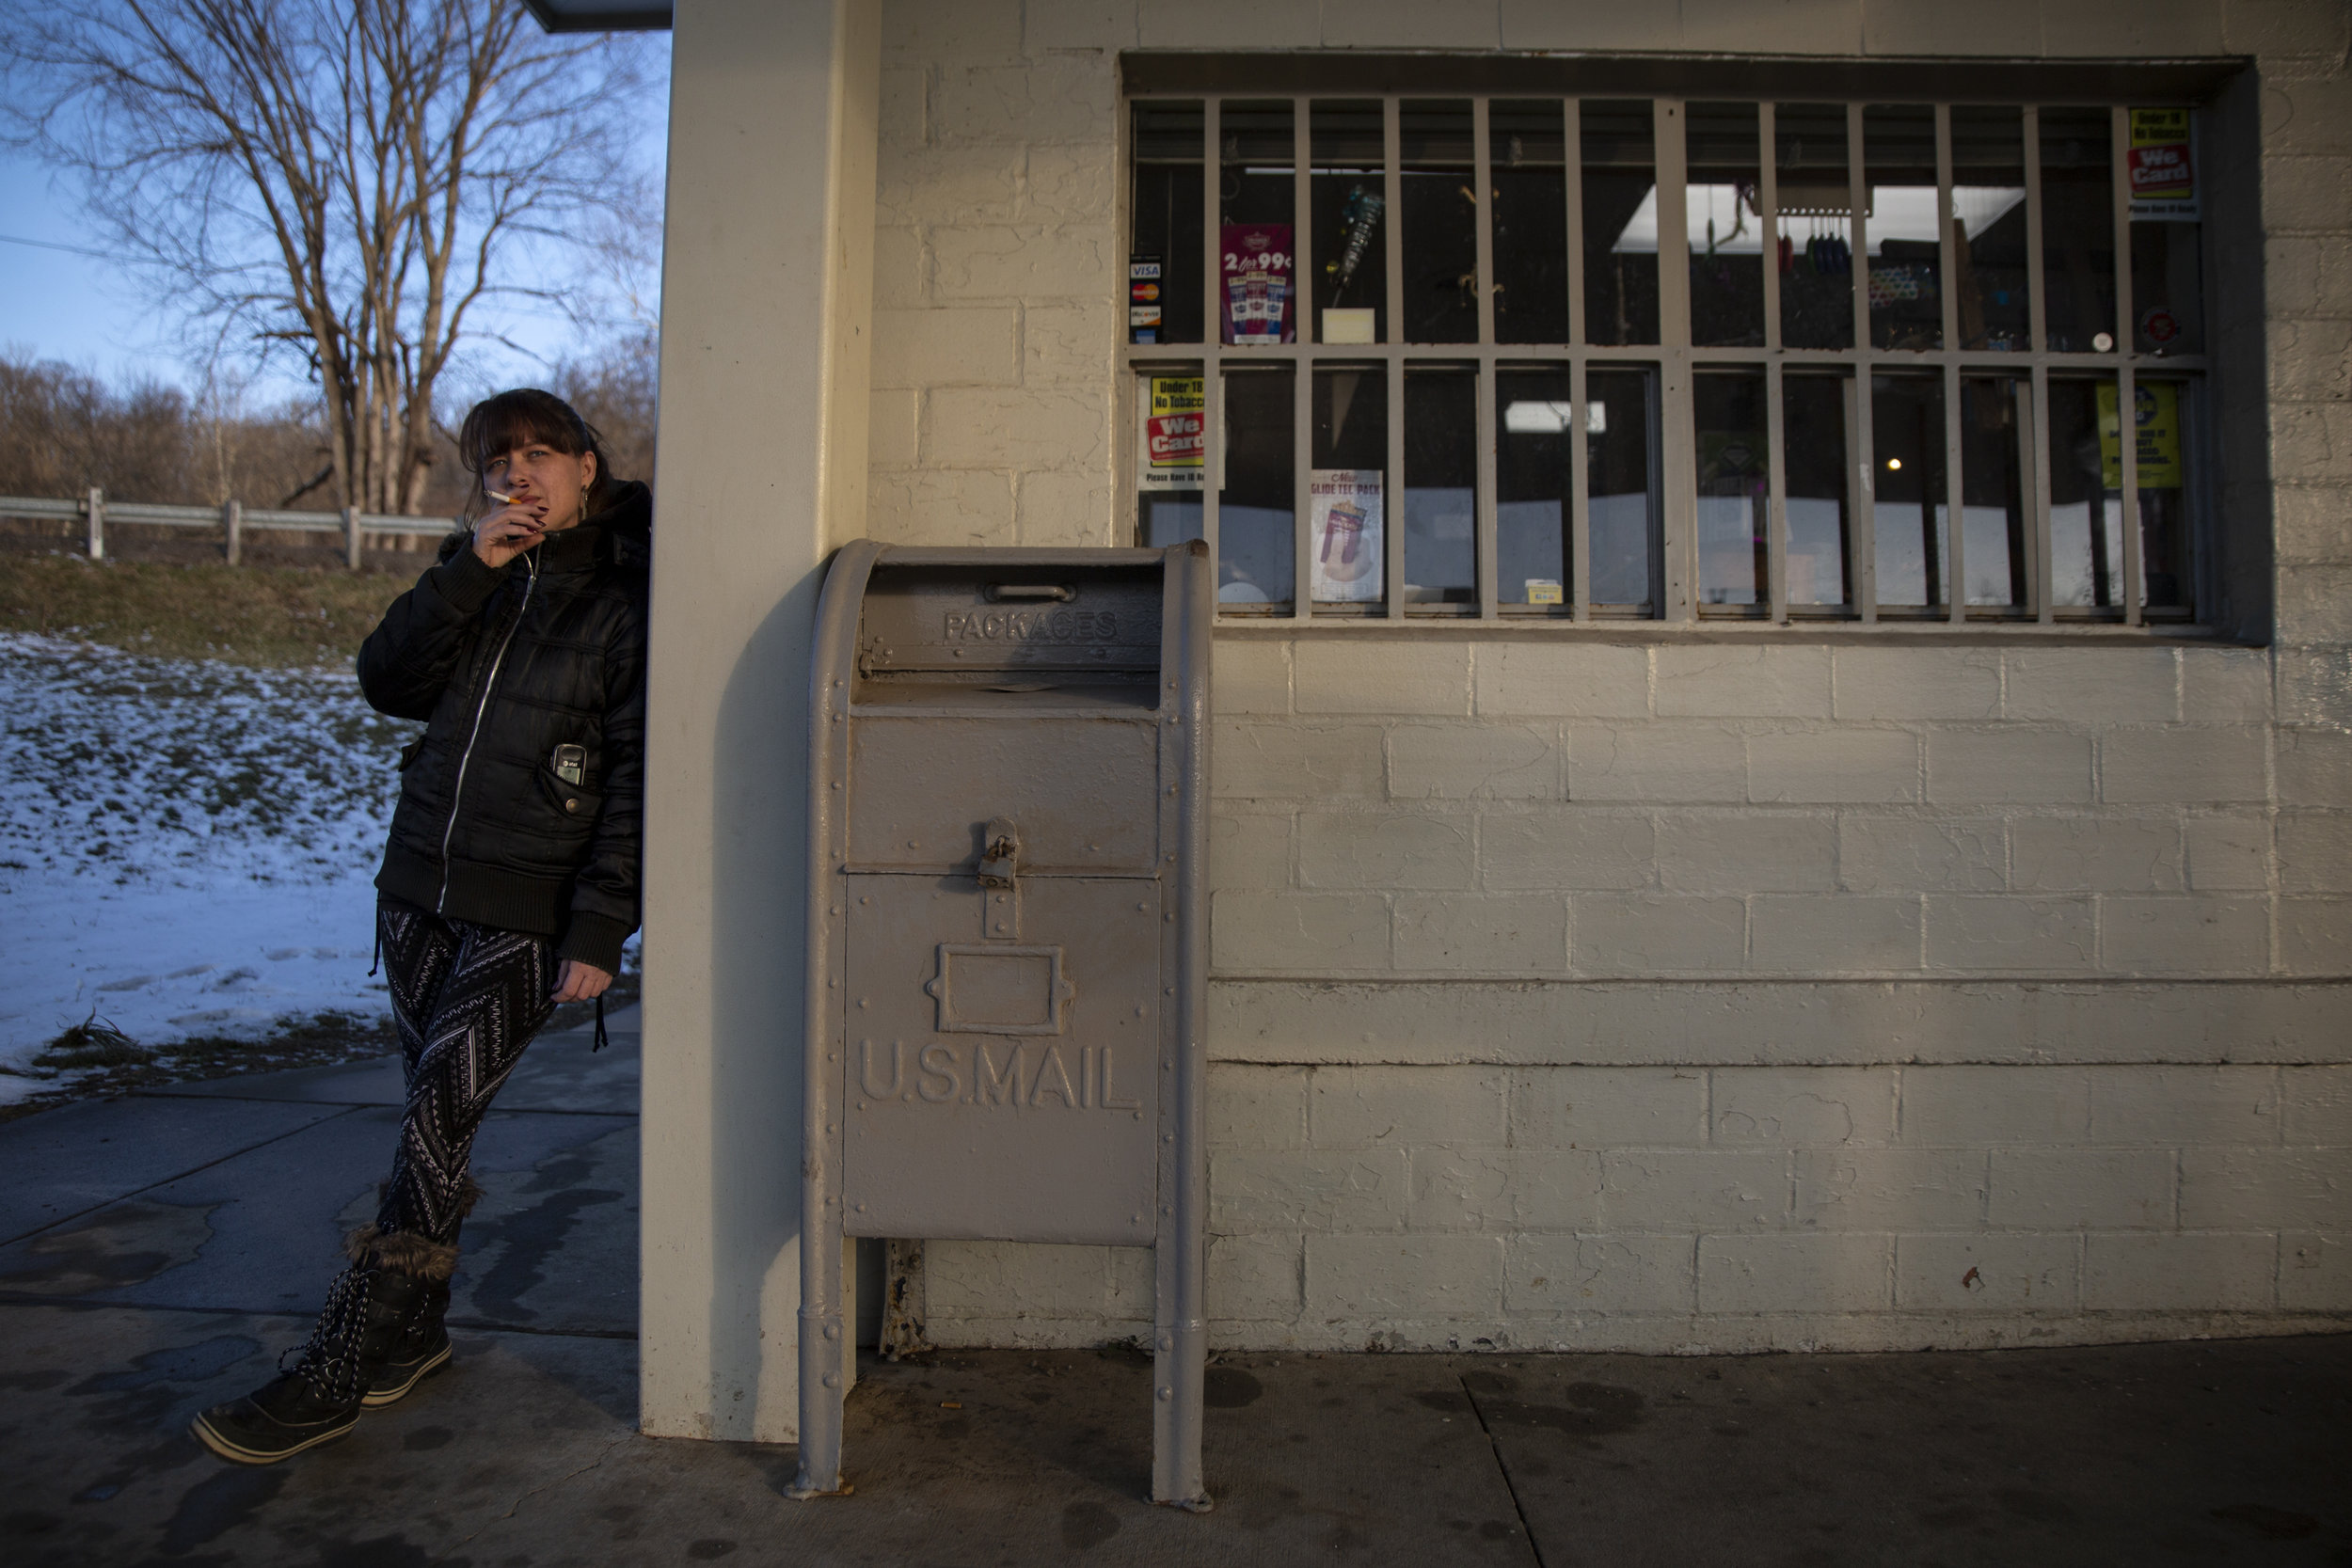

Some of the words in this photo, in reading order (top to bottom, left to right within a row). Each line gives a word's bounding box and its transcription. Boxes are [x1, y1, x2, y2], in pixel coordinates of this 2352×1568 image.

[2138, 149, 2179, 166] We
[2131, 162, 2190, 183] Card
[1224, 252, 1238, 271] 2
[1238, 256, 1257, 272] for
[1134, 266, 1159, 276] VISA
[1160, 381, 1189, 393] Under
[1192, 381, 1203, 393] 18
[1155, 396, 1168, 408] No
[1169, 396, 1204, 408] Tobacc
[1159, 417, 1200, 436] We
[1146, 473, 1168, 482] Please
[1170, 473, 1186, 482] Have
[1311, 483, 1336, 495] GLIDE
[1338, 483, 1354, 495] TEC
[1357, 483, 1380, 495] PACK
[944, 611, 1118, 641] PACKAGES
[974, 1044, 1141, 1110] MAIL
